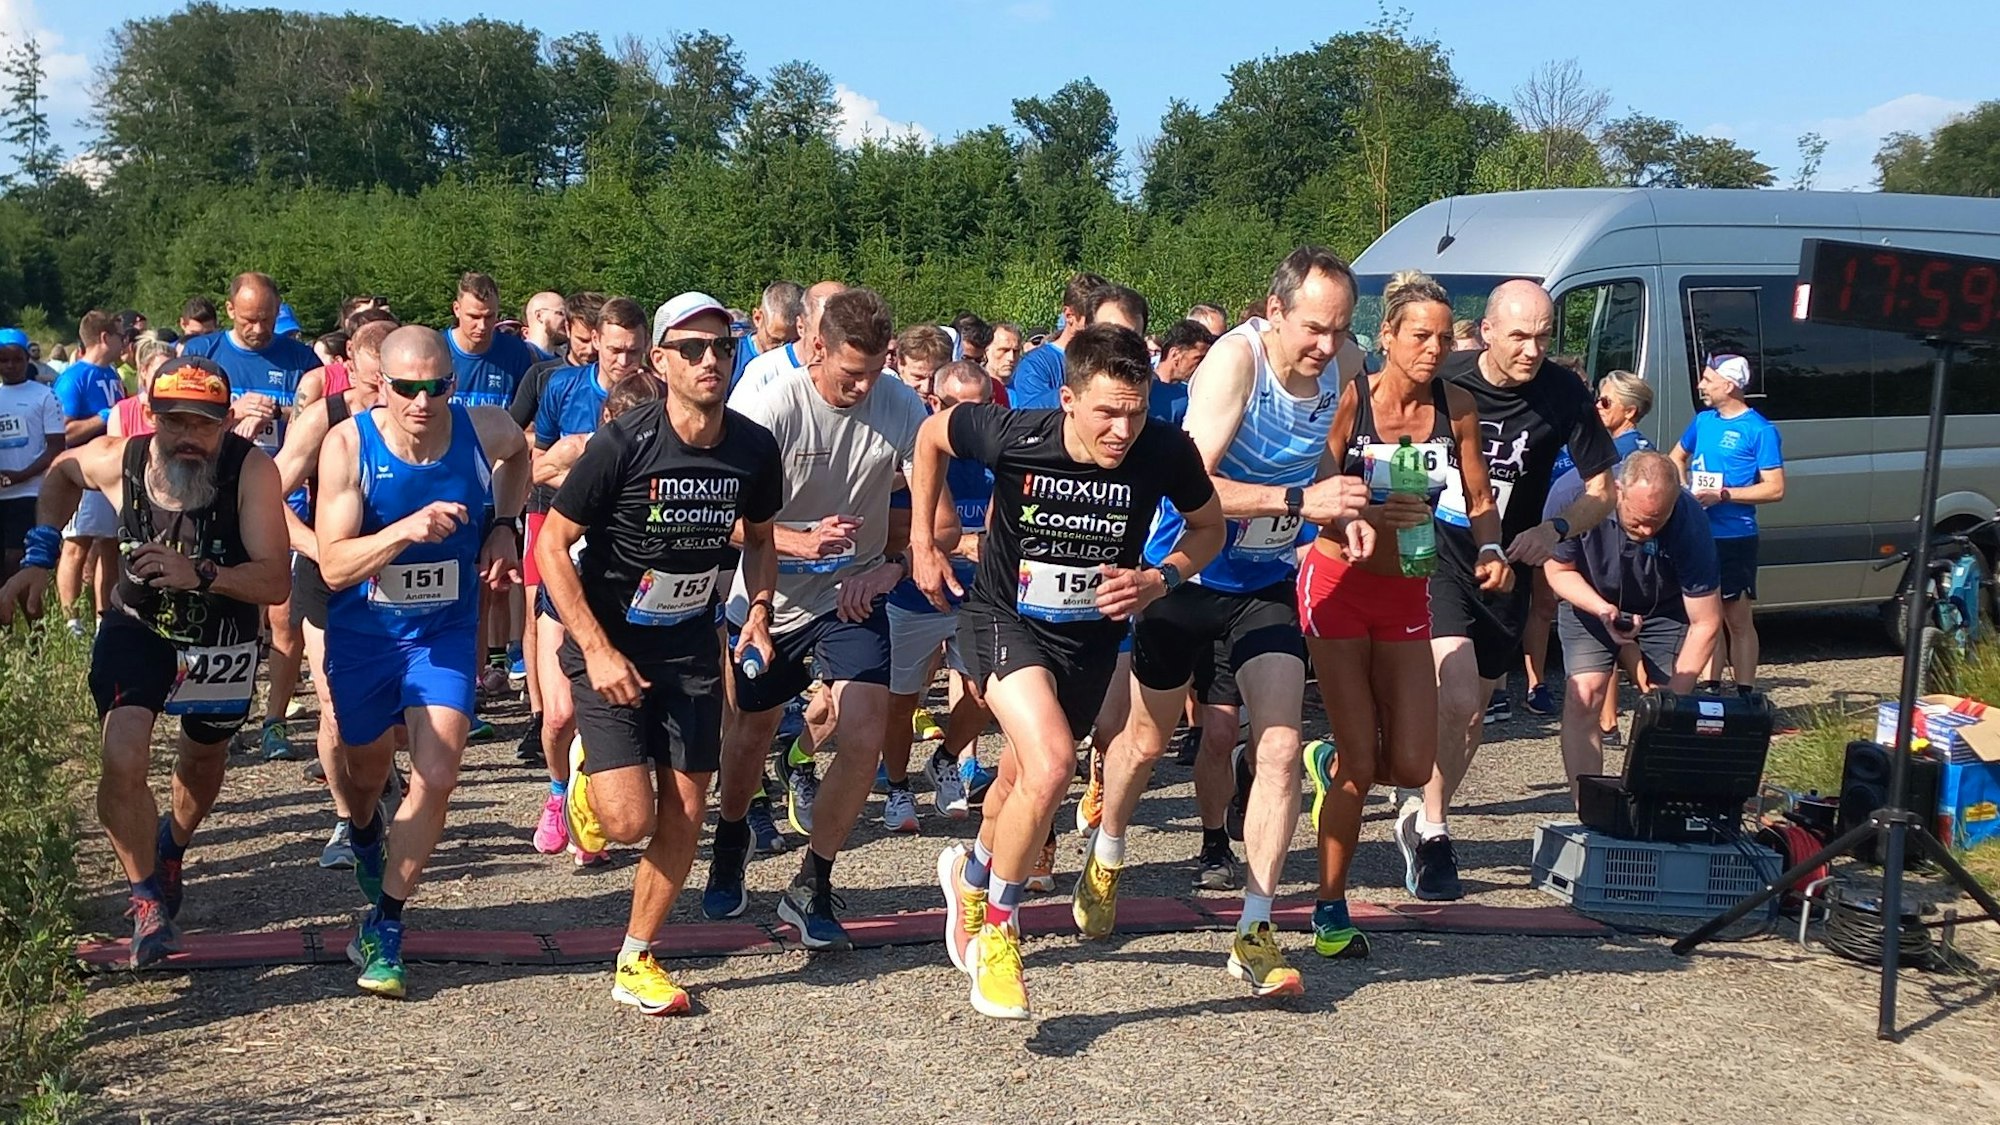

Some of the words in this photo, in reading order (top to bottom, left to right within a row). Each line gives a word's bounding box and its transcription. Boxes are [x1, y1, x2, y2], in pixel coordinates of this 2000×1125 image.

[1396, 450, 1437, 472] 116
[1032, 474, 1131, 502] maxum
[1697, 475, 1716, 488] 552
[401, 567, 445, 589] 151
[673, 575, 711, 598] 153
[1055, 571, 1104, 594] 154
[405, 592, 441, 600] Andreas
[1063, 597, 1091, 606] Moritz
[188, 652, 251, 685] 422
